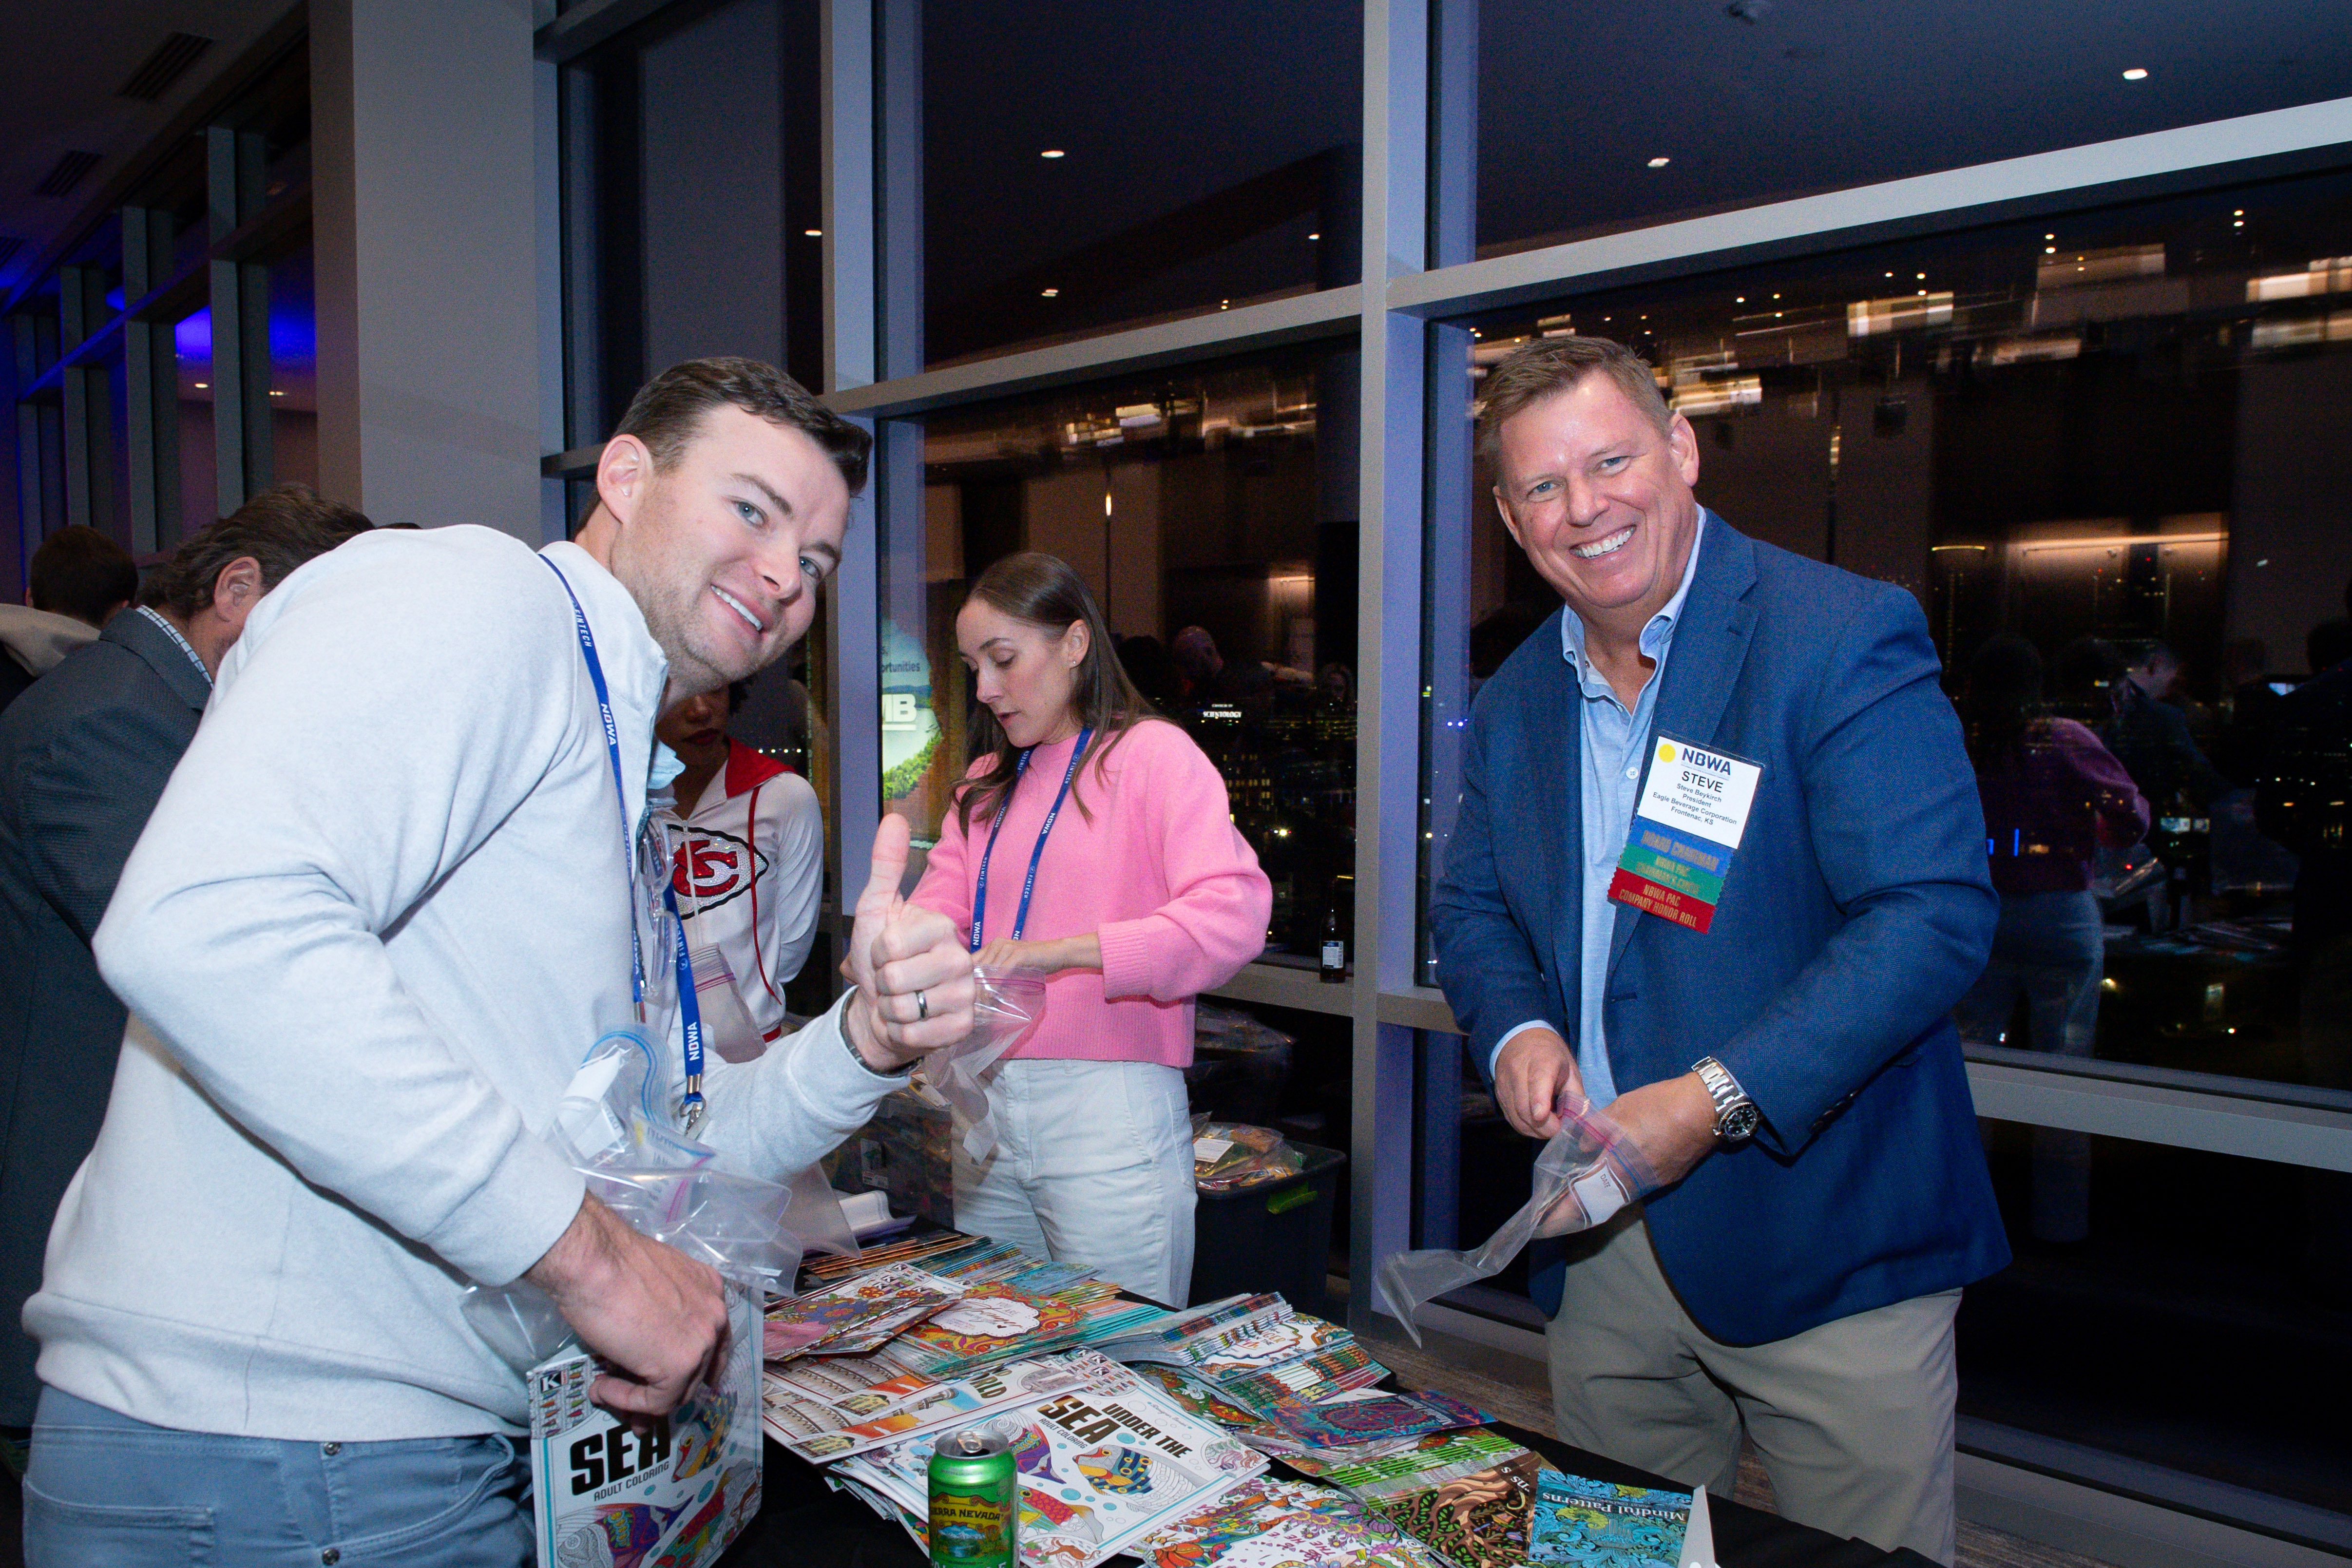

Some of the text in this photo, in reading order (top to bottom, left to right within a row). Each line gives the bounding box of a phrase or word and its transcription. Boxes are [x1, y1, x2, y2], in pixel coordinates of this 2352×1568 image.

[575, 609, 592, 647] FINTECH
[1682, 747, 1731, 776] NBWA
[1677, 783, 1722, 803] Steve Beykirch
[1682, 771, 1724, 793] STEVE
[1653, 792, 1737, 825] Eagle Beverage Corporation
[1671, 806, 1702, 823] Frontenac,
[1683, 794, 1712, 808] President
[1024, 875, 1033, 899] FINTECH
[1643, 884, 1681, 907] NBWA PAC
[1619, 888, 1698, 928] COMPANY HONOR ROLL
[1600, 1173, 1611, 1189] DATE
[542, 1373, 560, 1392] K
[1036, 1395, 1121, 1445] SEA
[1039, 1418, 1089, 1449] ADULT COLORING
[1101, 1403, 1193, 1458] UNDER THE
[570, 1416, 671, 1496] SEA
[594, 1461, 670, 1502] ADULT COLORING
[959, 1509, 1000, 1521] NEVADA
[1543, 1492, 1686, 1521] Mindful Patterns
